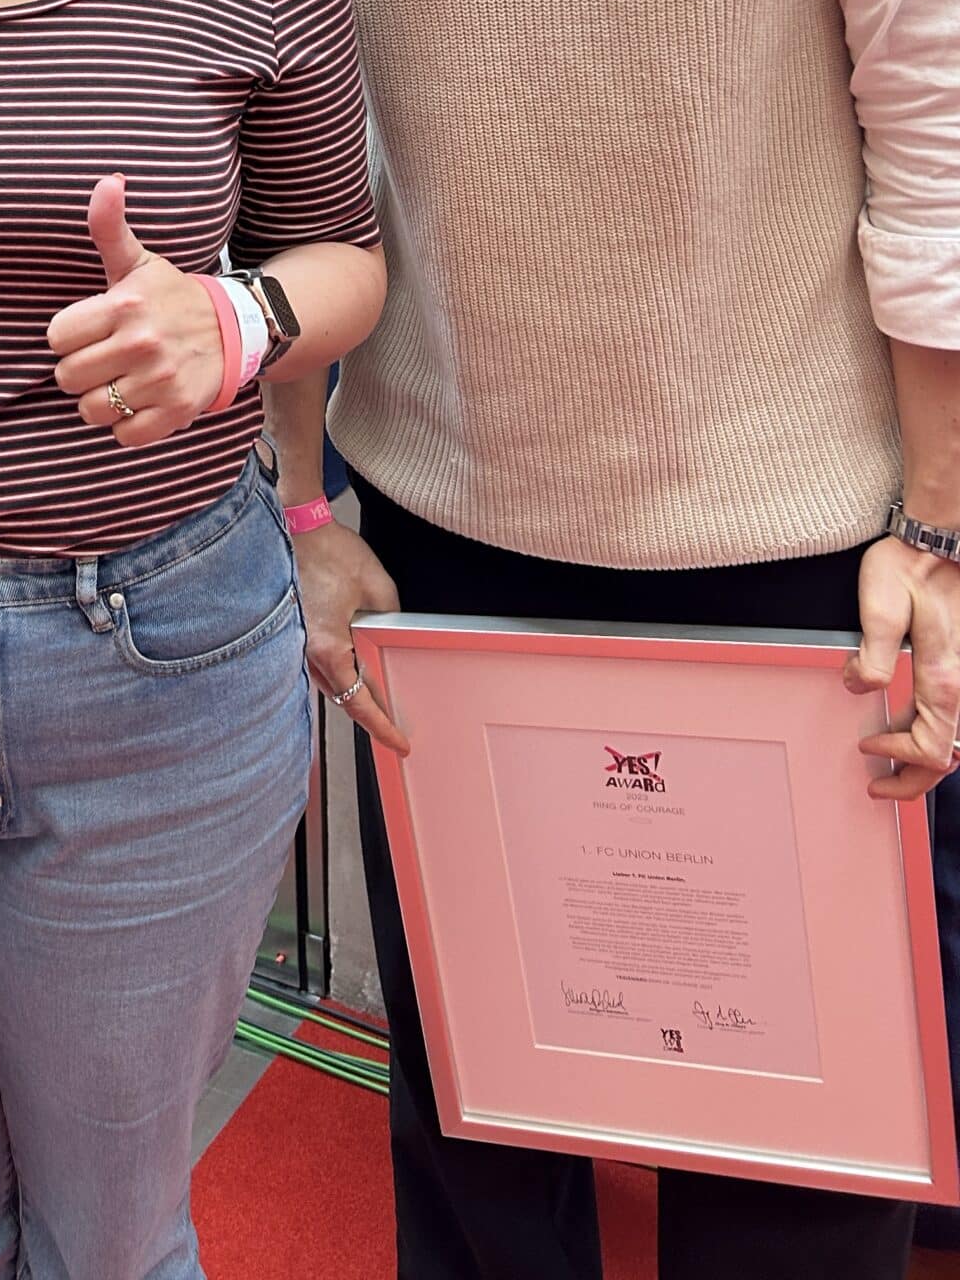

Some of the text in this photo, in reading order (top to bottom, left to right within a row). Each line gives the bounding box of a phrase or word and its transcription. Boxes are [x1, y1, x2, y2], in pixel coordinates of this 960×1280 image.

[592, 801, 686, 816] RING OF COURAGE
[596, 846, 615, 857] FC
[618, 847, 662, 861] UNION
[665, 852, 714, 865] BERLIN
